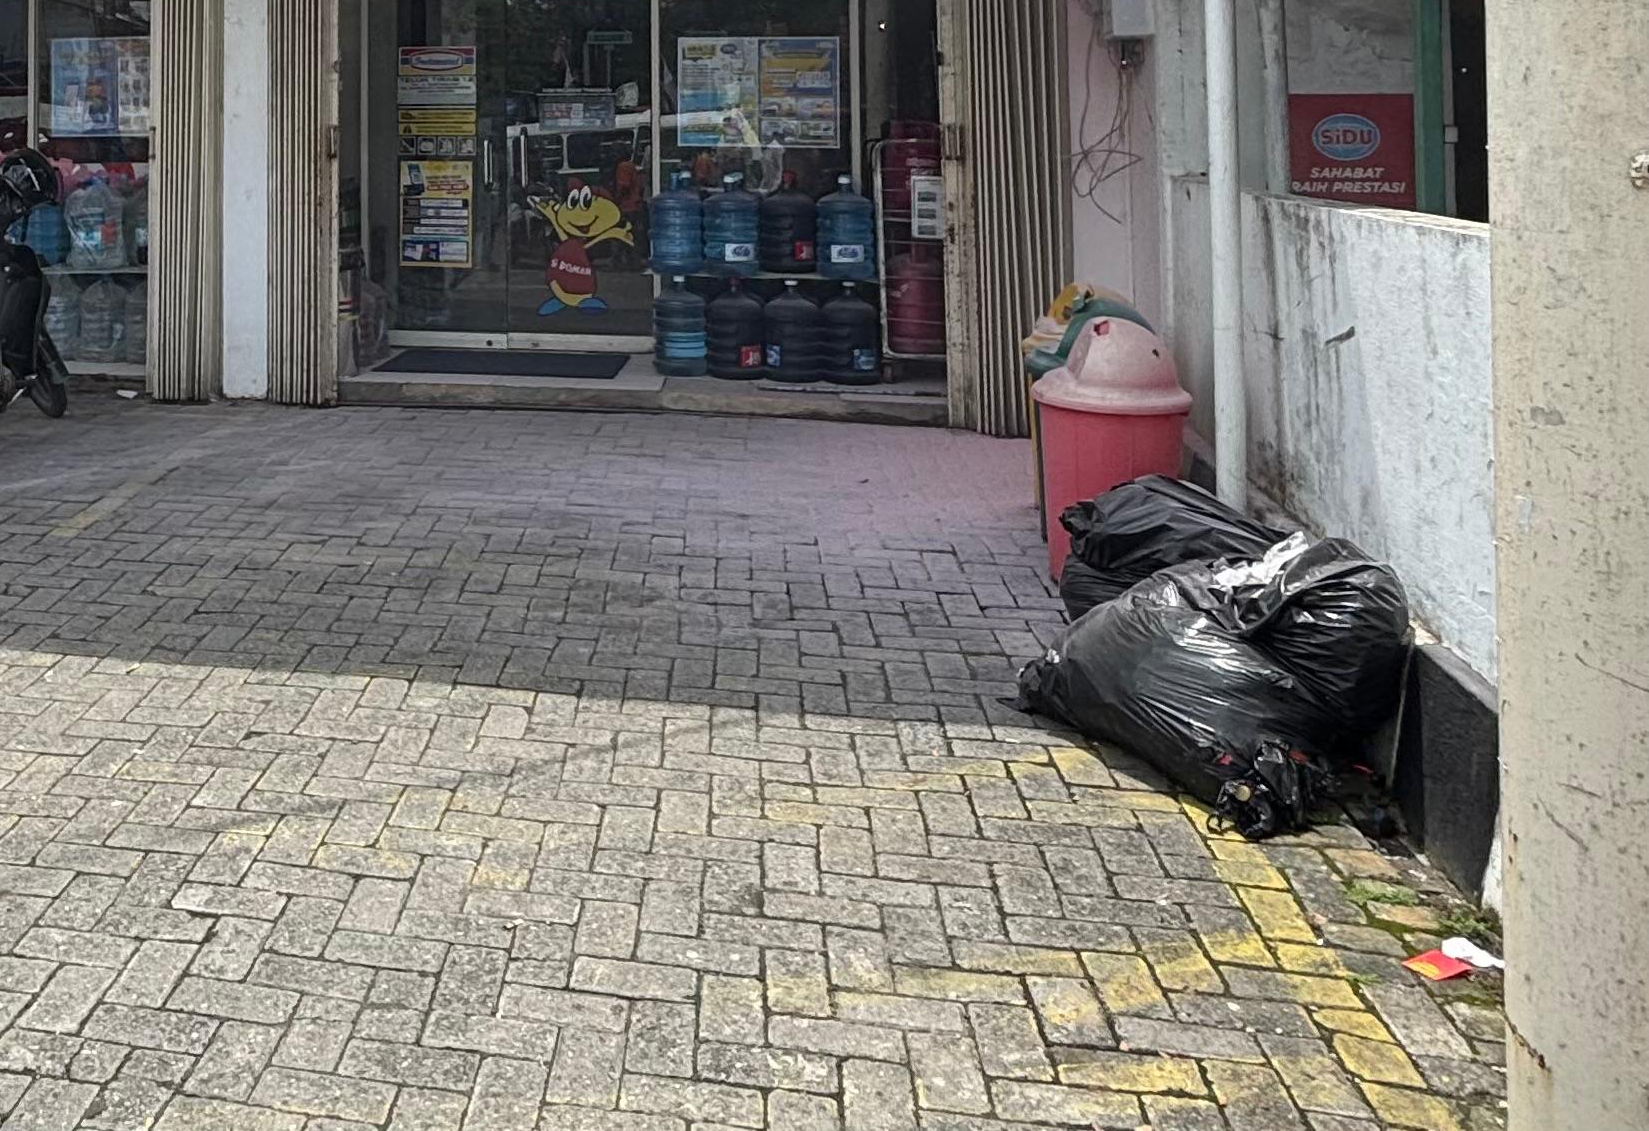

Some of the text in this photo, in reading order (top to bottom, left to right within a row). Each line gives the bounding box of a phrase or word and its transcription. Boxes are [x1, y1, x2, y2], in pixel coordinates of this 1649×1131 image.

[1310, 167, 1385, 179] SAHABAT
[1292, 180, 1406, 194] RAIH PRESTASI
